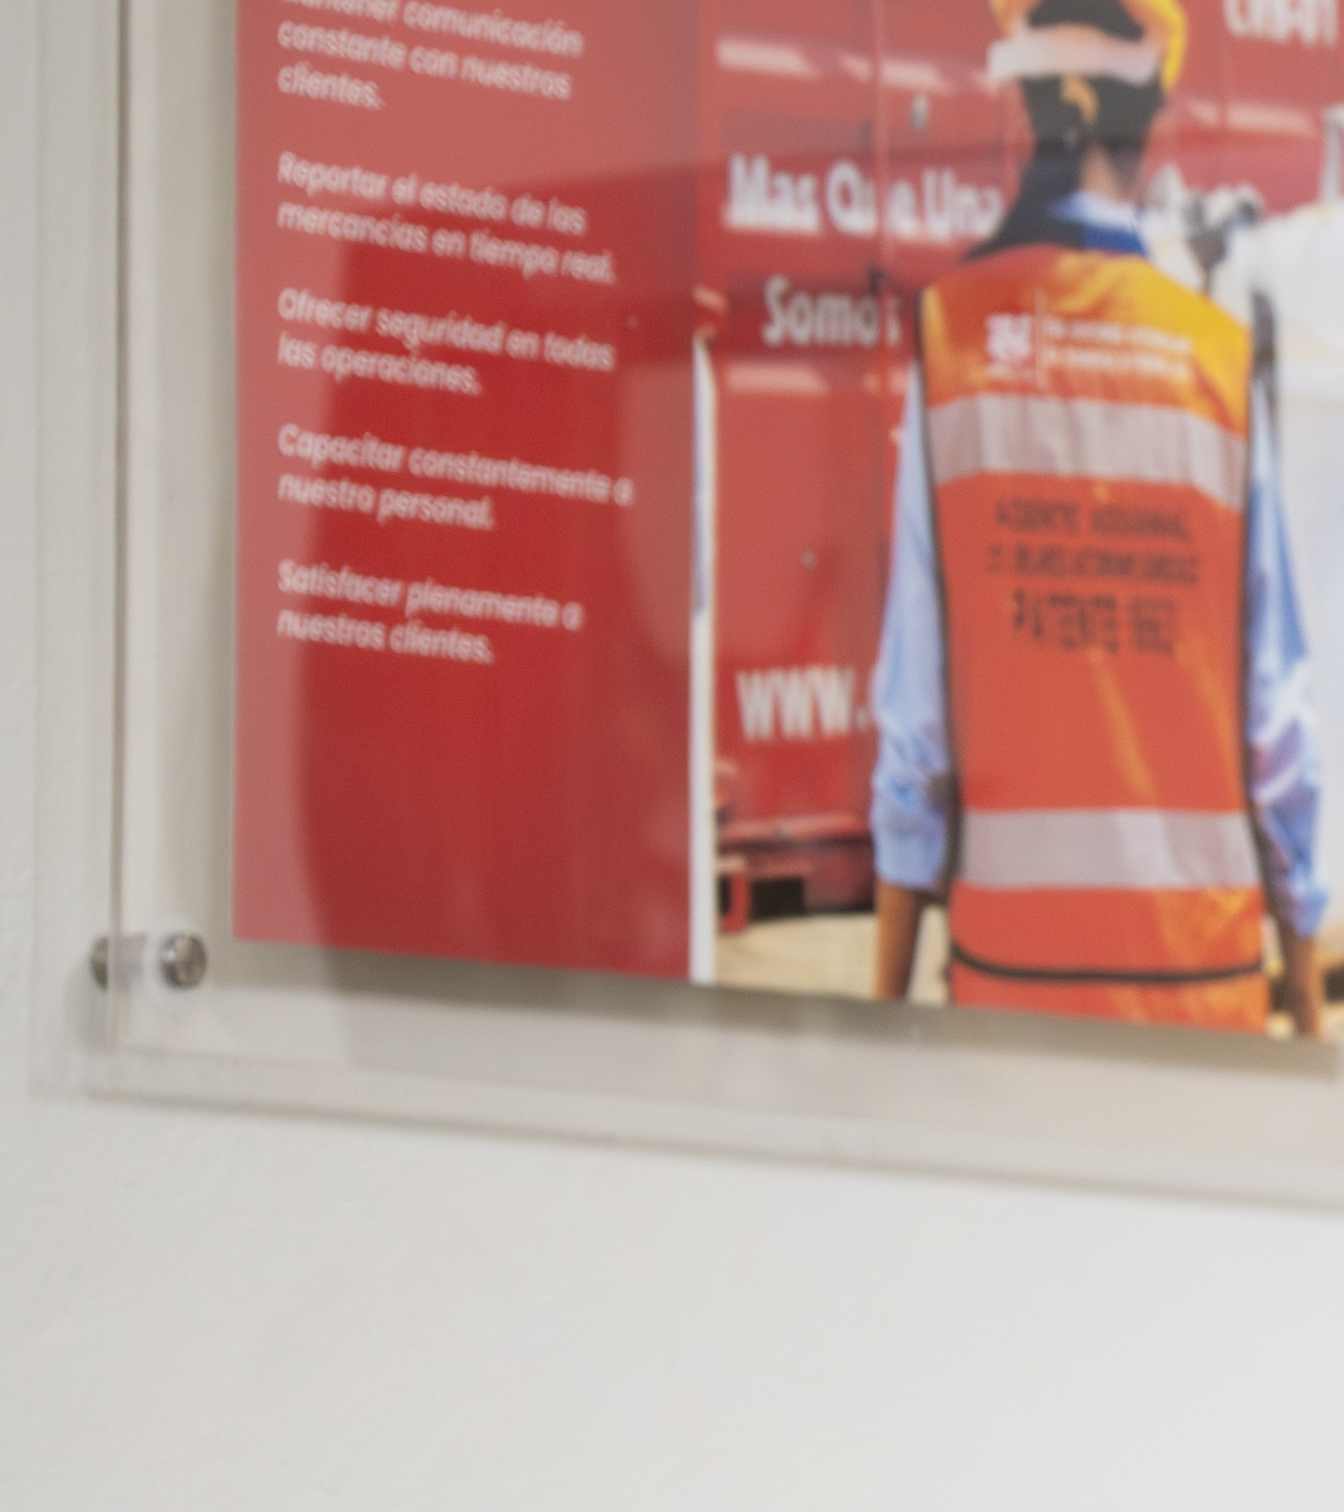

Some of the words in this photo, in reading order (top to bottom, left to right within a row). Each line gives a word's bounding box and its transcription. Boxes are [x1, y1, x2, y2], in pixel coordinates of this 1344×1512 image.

[277, 19, 407, 69] constante
[409, 44, 458, 78] con
[461, 53, 573, 101] nuestros
[277, 151, 388, 200] Reportar
[391, 172, 416, 205] el
[419, 178, 506, 221] estado
[510, 193, 545, 229] de
[549, 198, 587, 236] las
[432, 222, 466, 256] en
[470, 225, 558, 279] tiempo
[277, 287, 371, 332] Ofrecer
[376, 302, 503, 356] seguridad
[506, 325, 541, 358] en
[544, 326, 615, 372] todas
[277, 334, 318, 370] las
[277, 423, 405, 471] Capacitar
[409, 447, 611, 504] constantemente
[613, 475, 635, 506] a
[277, 474, 376, 514] nuestro
[277, 558, 402, 607] Satisfacer
[405, 577, 560, 629] plenamente
[562, 601, 584, 631] a
[277, 608, 387, 651] nuestros
